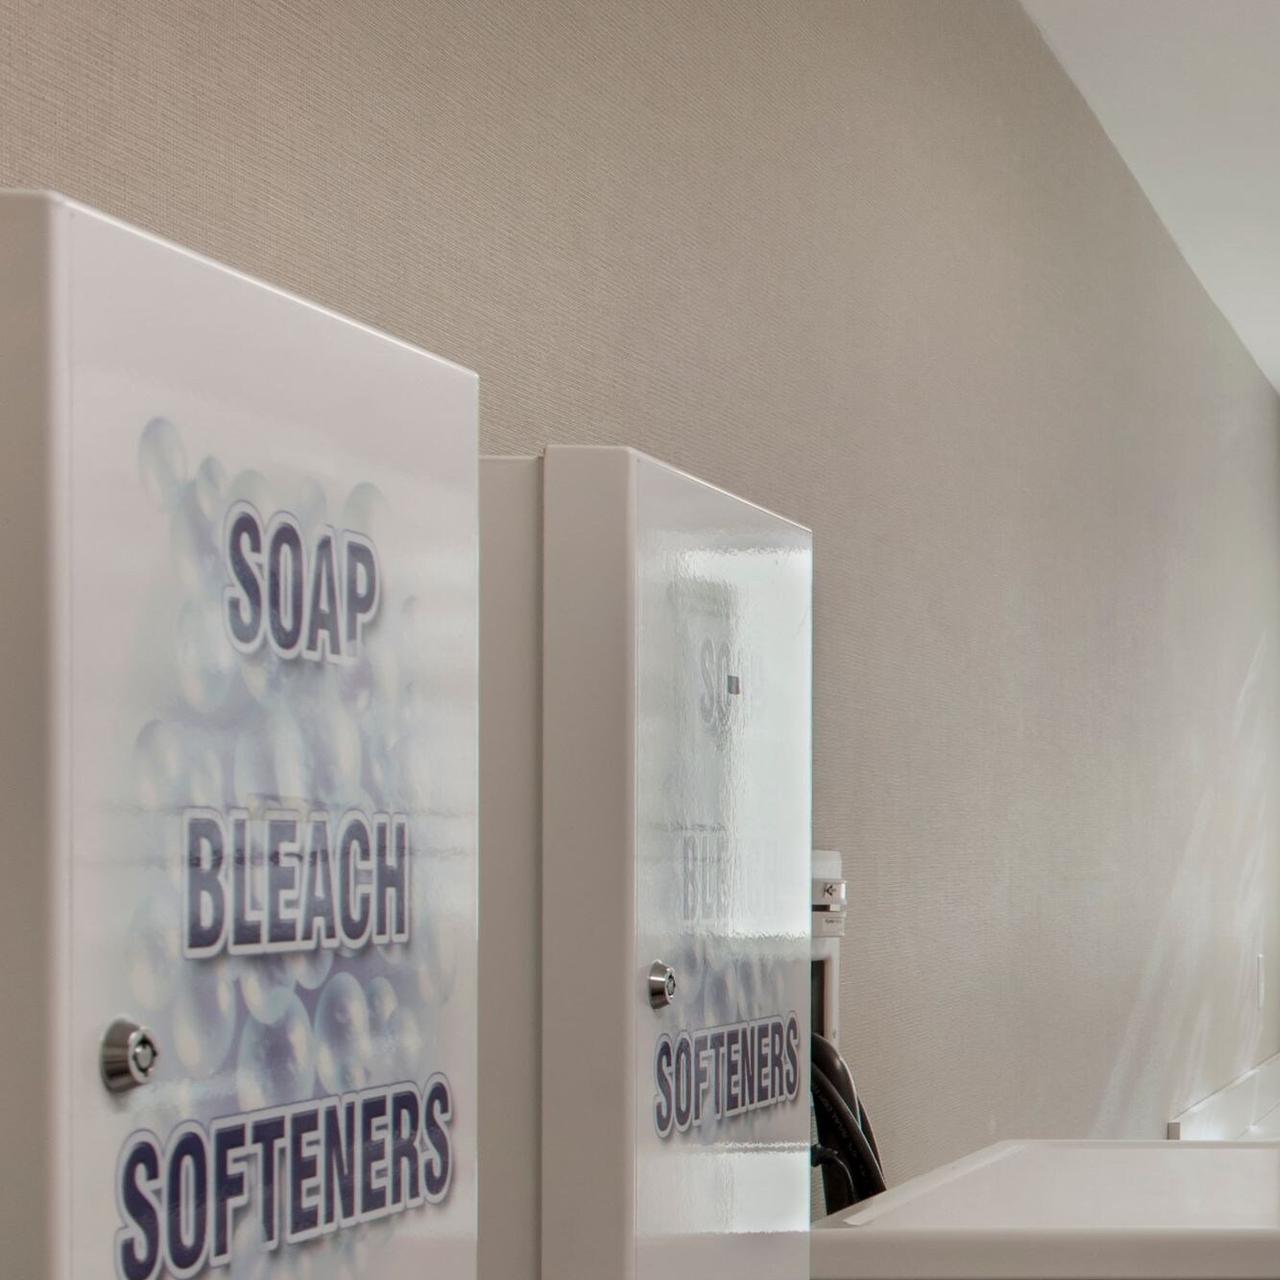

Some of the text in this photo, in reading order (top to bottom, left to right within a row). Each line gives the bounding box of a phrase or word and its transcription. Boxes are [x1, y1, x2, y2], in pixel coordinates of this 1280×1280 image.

[226, 503, 379, 661] SOAP
[184, 811, 409, 956] BLEACH
[654, 1010, 800, 1137] SOFTENERS
